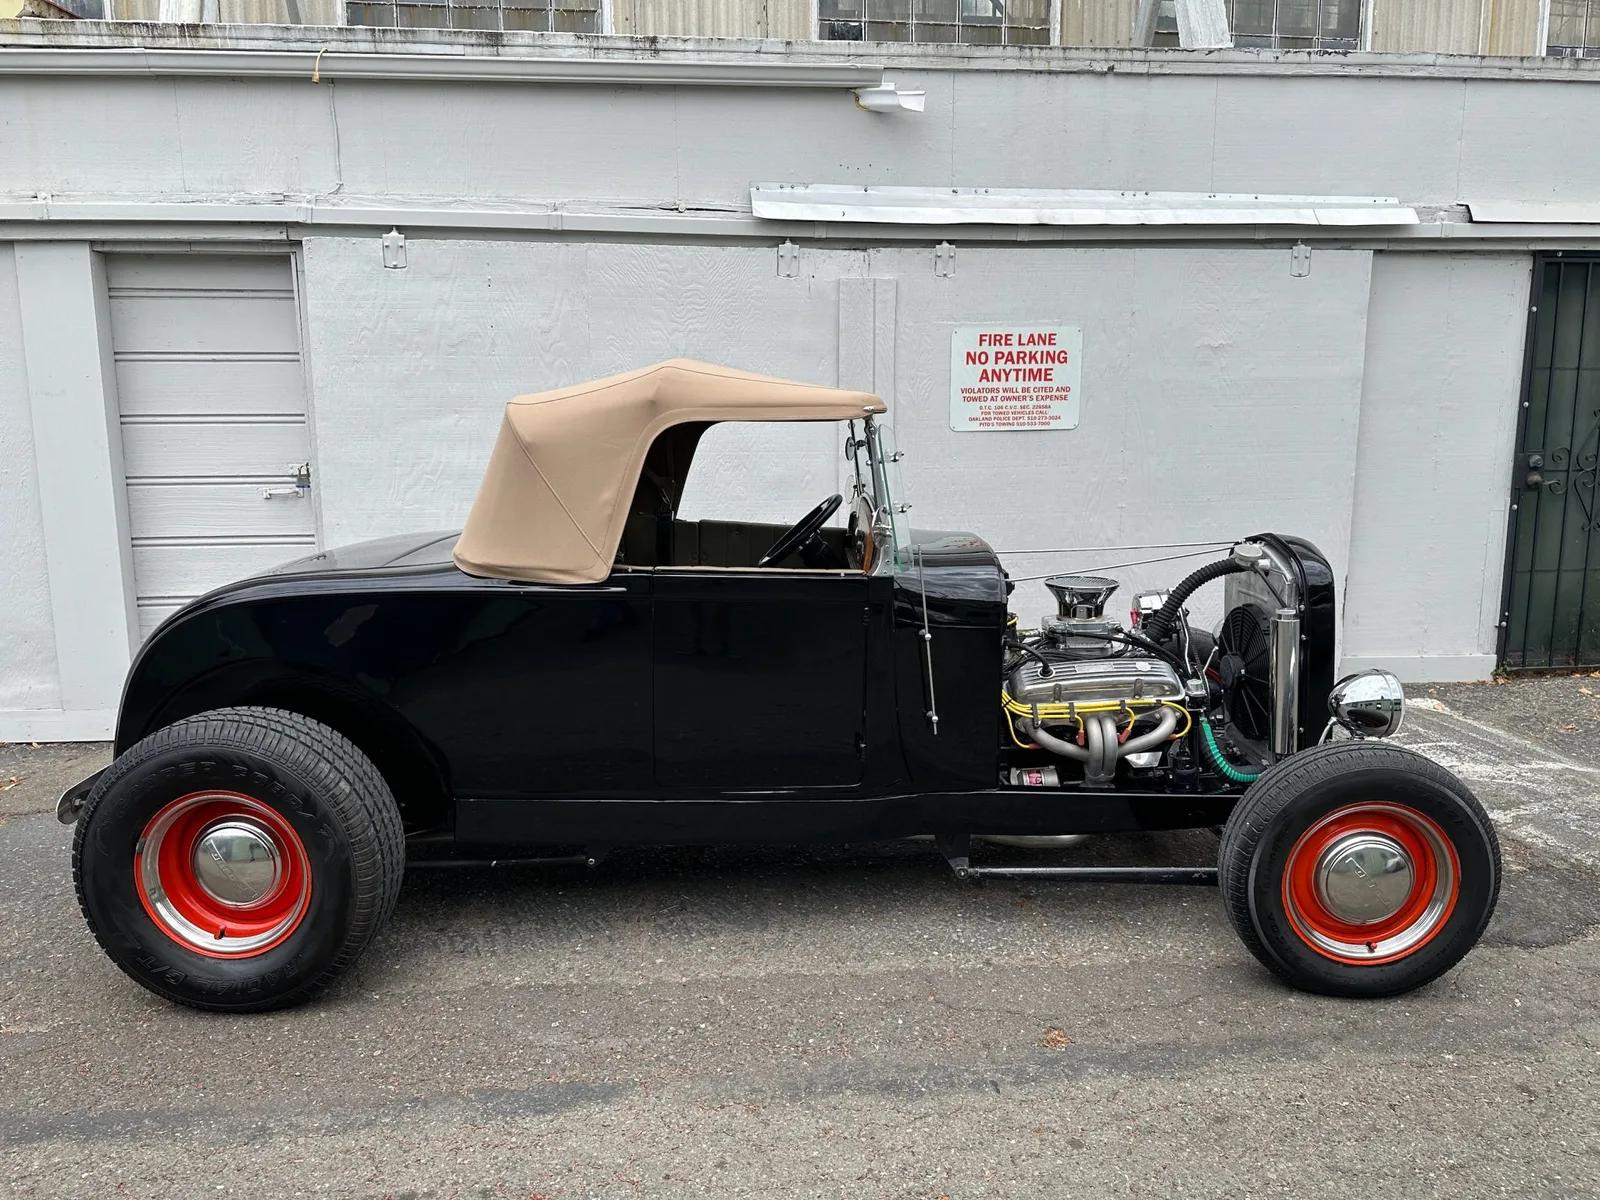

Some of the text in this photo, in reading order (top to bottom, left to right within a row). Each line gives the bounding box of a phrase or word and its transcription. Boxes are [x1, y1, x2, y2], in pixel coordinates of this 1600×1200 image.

[979, 333, 1057, 346] FIRE LANE
[966, 350, 1068, 365] NO PARKING
[979, 368, 1053, 382] ANYTIME
[137, 954, 188, 985] G/T
